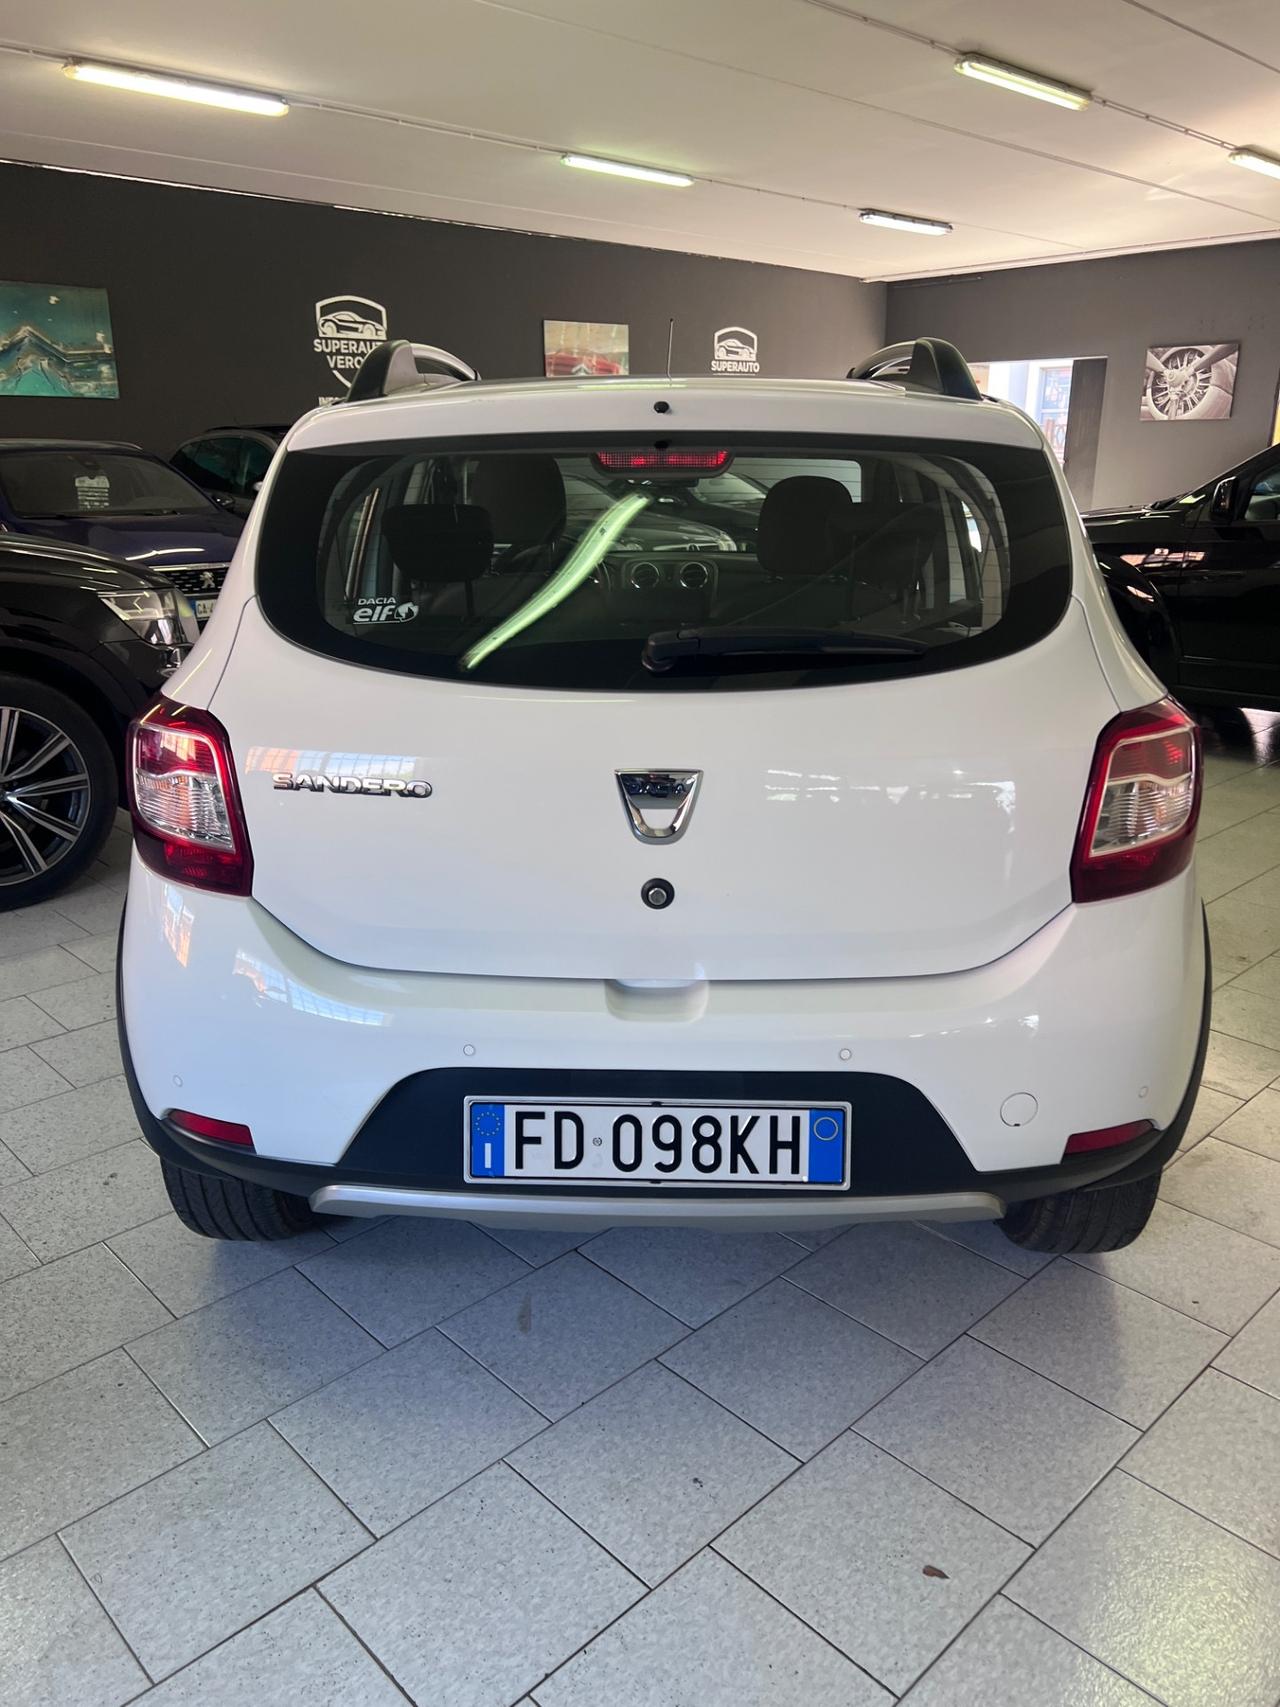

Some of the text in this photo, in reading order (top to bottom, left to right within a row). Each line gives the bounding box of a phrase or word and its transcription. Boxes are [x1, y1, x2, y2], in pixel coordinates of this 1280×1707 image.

[711, 360, 760, 373] SUPERAUTO
[358, 597, 397, 606] DACIA
[353, 605, 396, 622] elf
[272, 772, 433, 798] SANDERO
